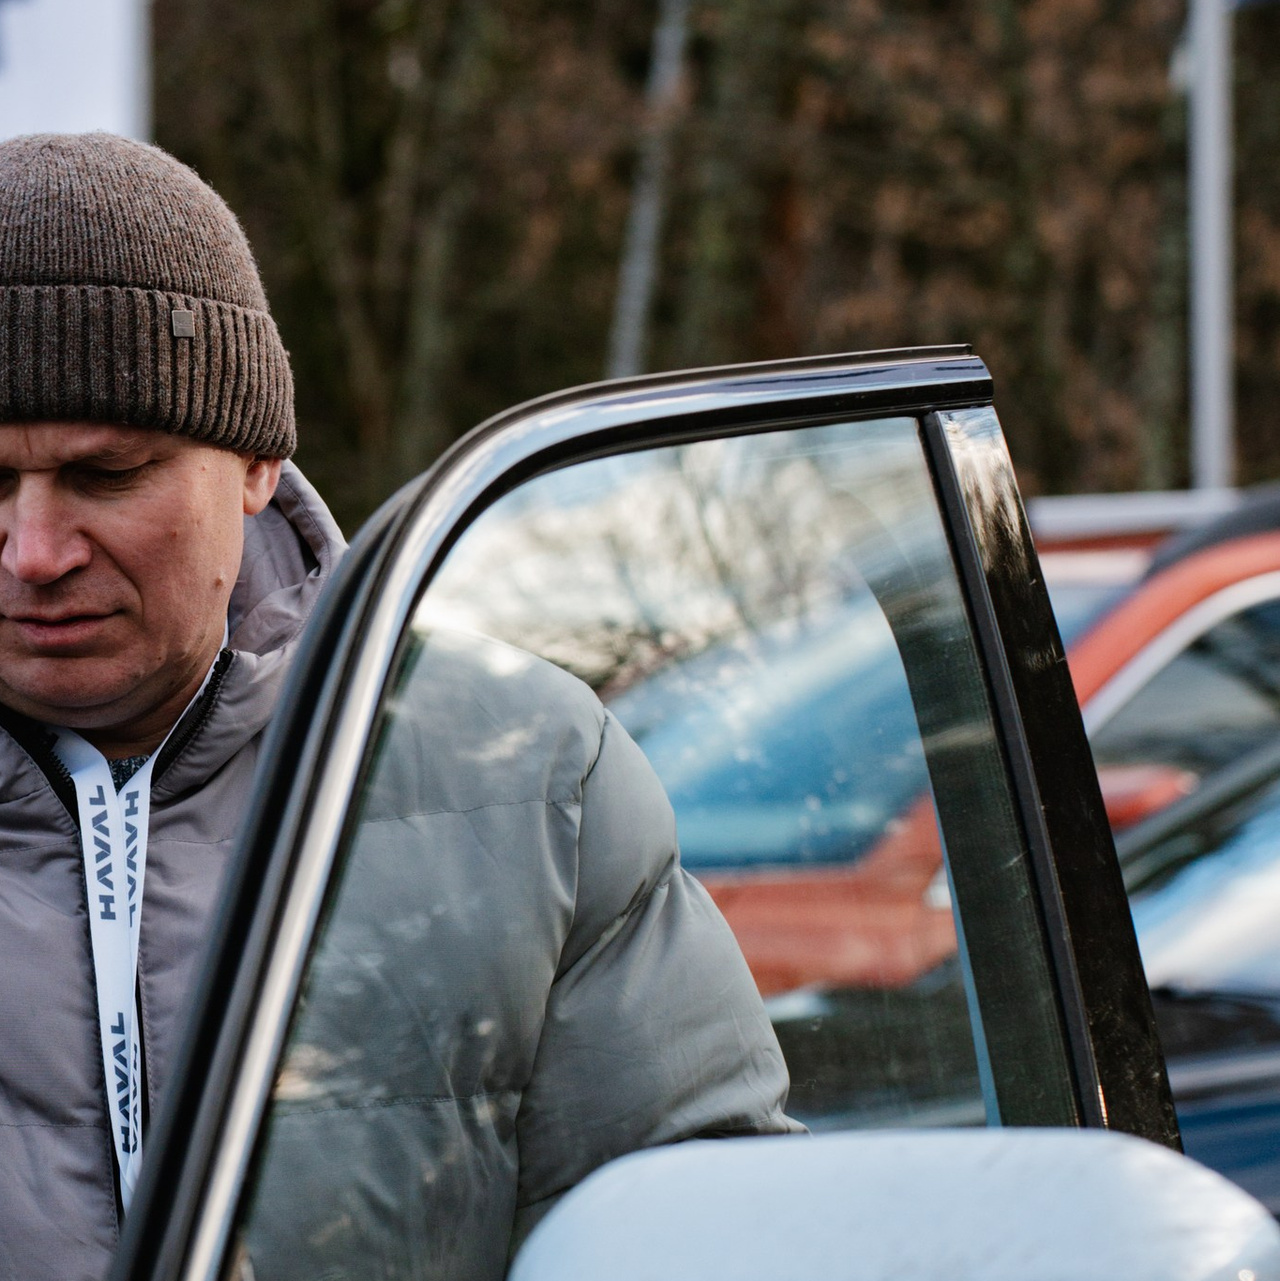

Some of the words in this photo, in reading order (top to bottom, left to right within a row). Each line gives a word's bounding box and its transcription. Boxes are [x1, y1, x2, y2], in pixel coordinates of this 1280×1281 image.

[88, 784, 117, 921] HAVAL
[124, 789, 140, 928] HAVAL
[110, 1011, 131, 1154] HAVAL
